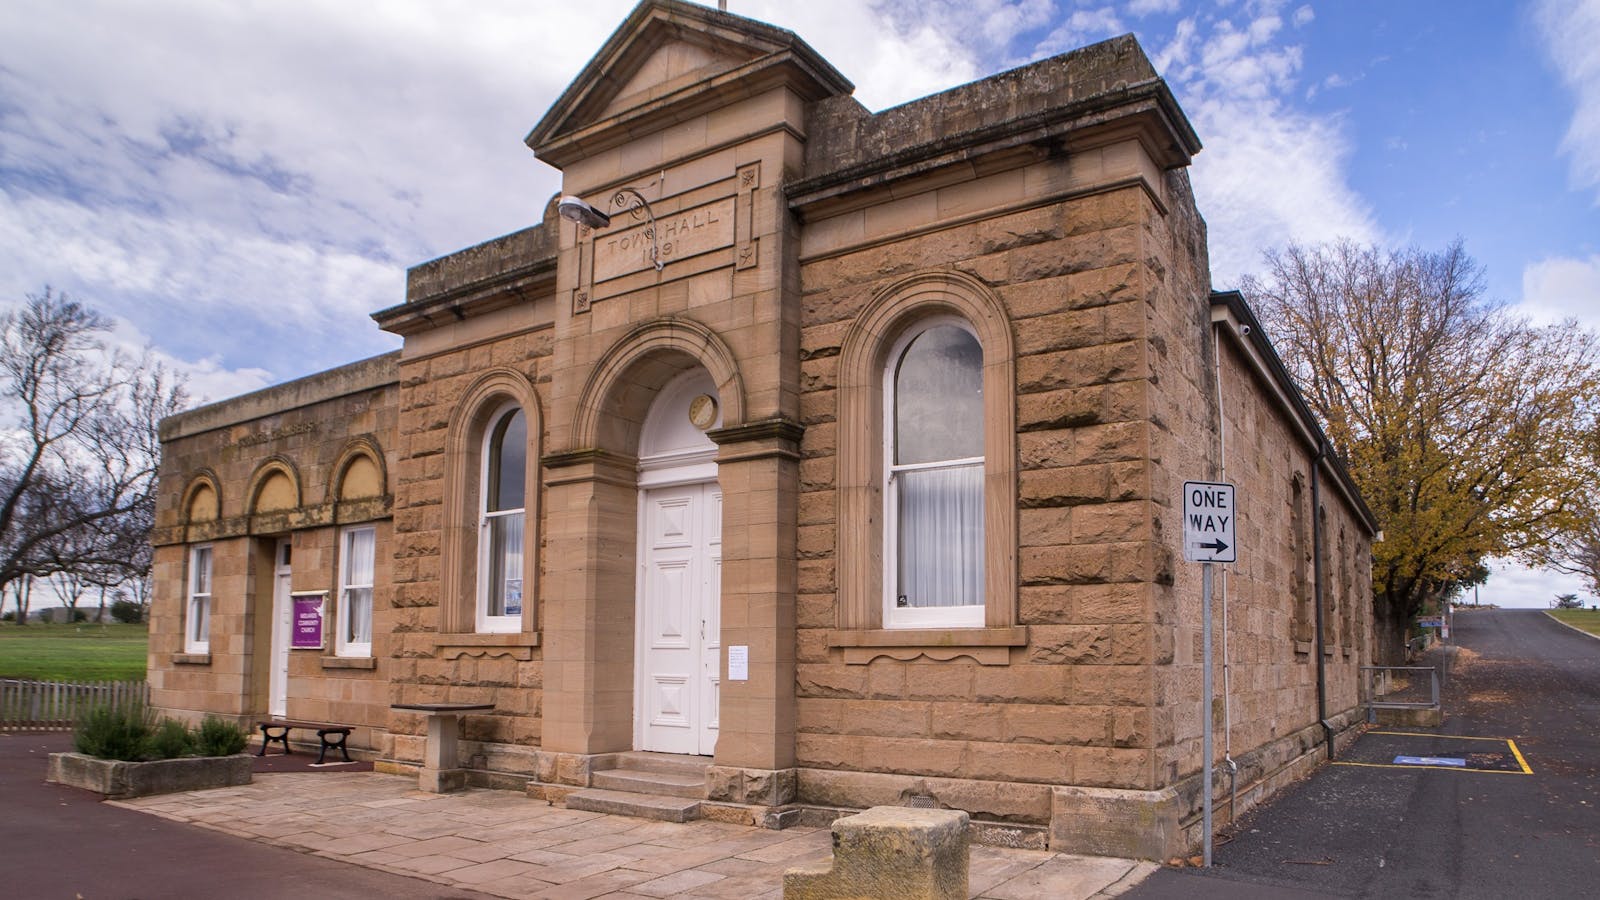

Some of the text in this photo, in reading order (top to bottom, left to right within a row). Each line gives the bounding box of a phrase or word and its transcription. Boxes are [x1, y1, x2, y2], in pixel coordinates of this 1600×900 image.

[607, 211, 719, 254] TOW HALL
[642, 239, 680, 262] 1891
[1192, 489, 1227, 508] ONE
[1189, 514, 1229, 533] WAY
